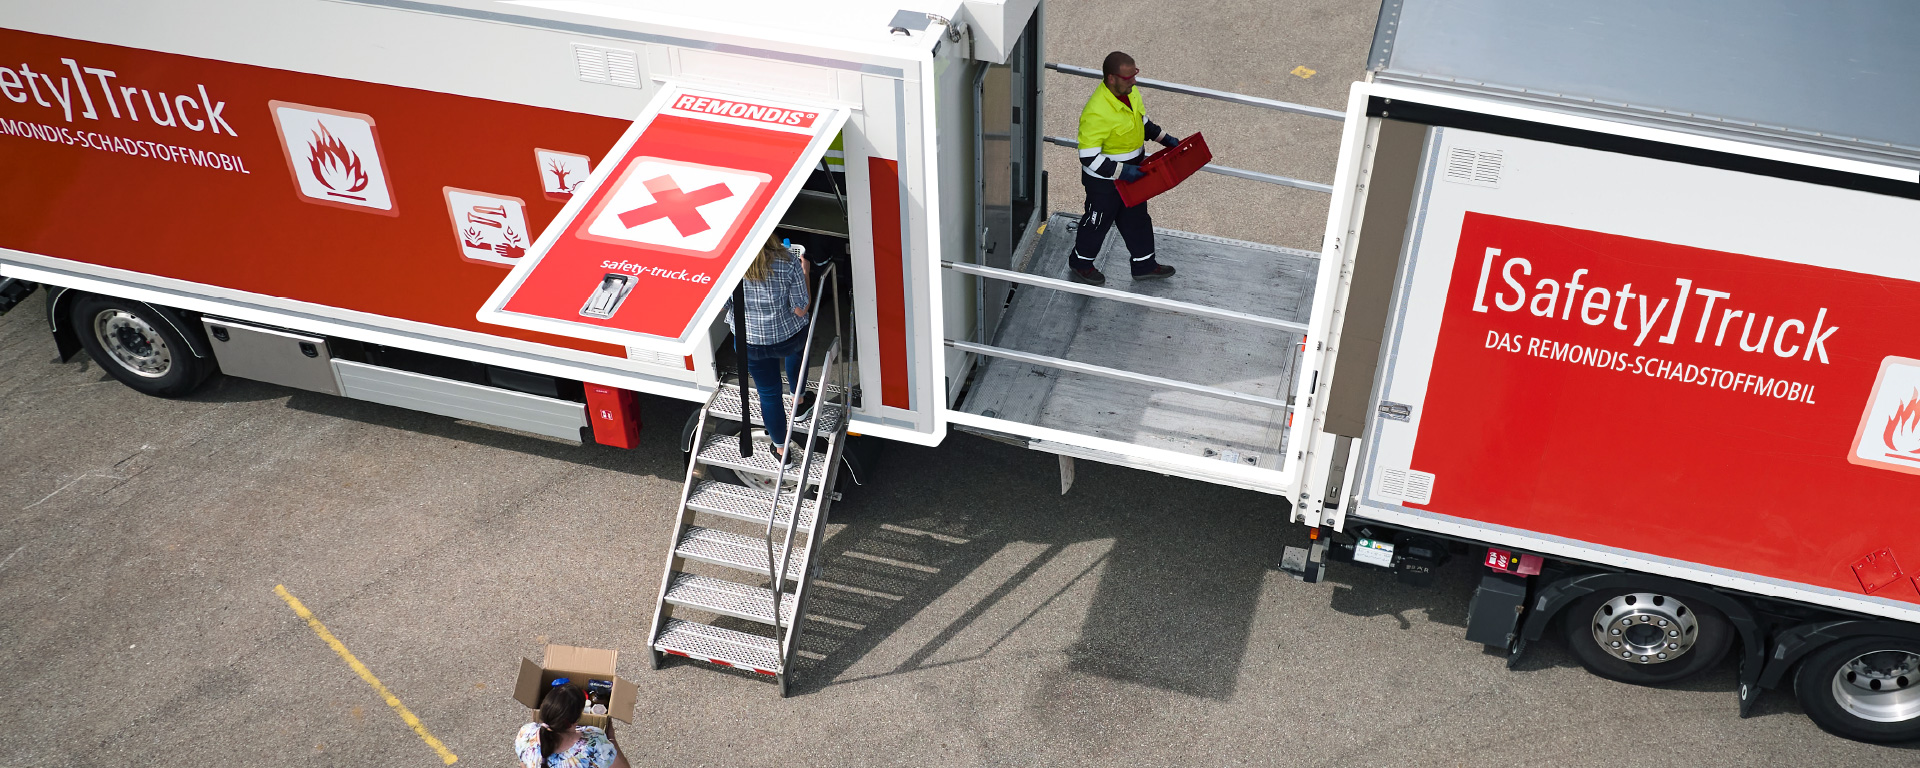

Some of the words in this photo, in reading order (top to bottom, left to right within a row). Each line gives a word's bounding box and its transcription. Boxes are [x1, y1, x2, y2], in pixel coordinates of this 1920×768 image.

[600, 259, 711, 284] safety-truck.de
[1485, 330, 1523, 353] DAS
[1527, 337, 1816, 405] REMONDIS-SCHADSTOFFMOBIL
